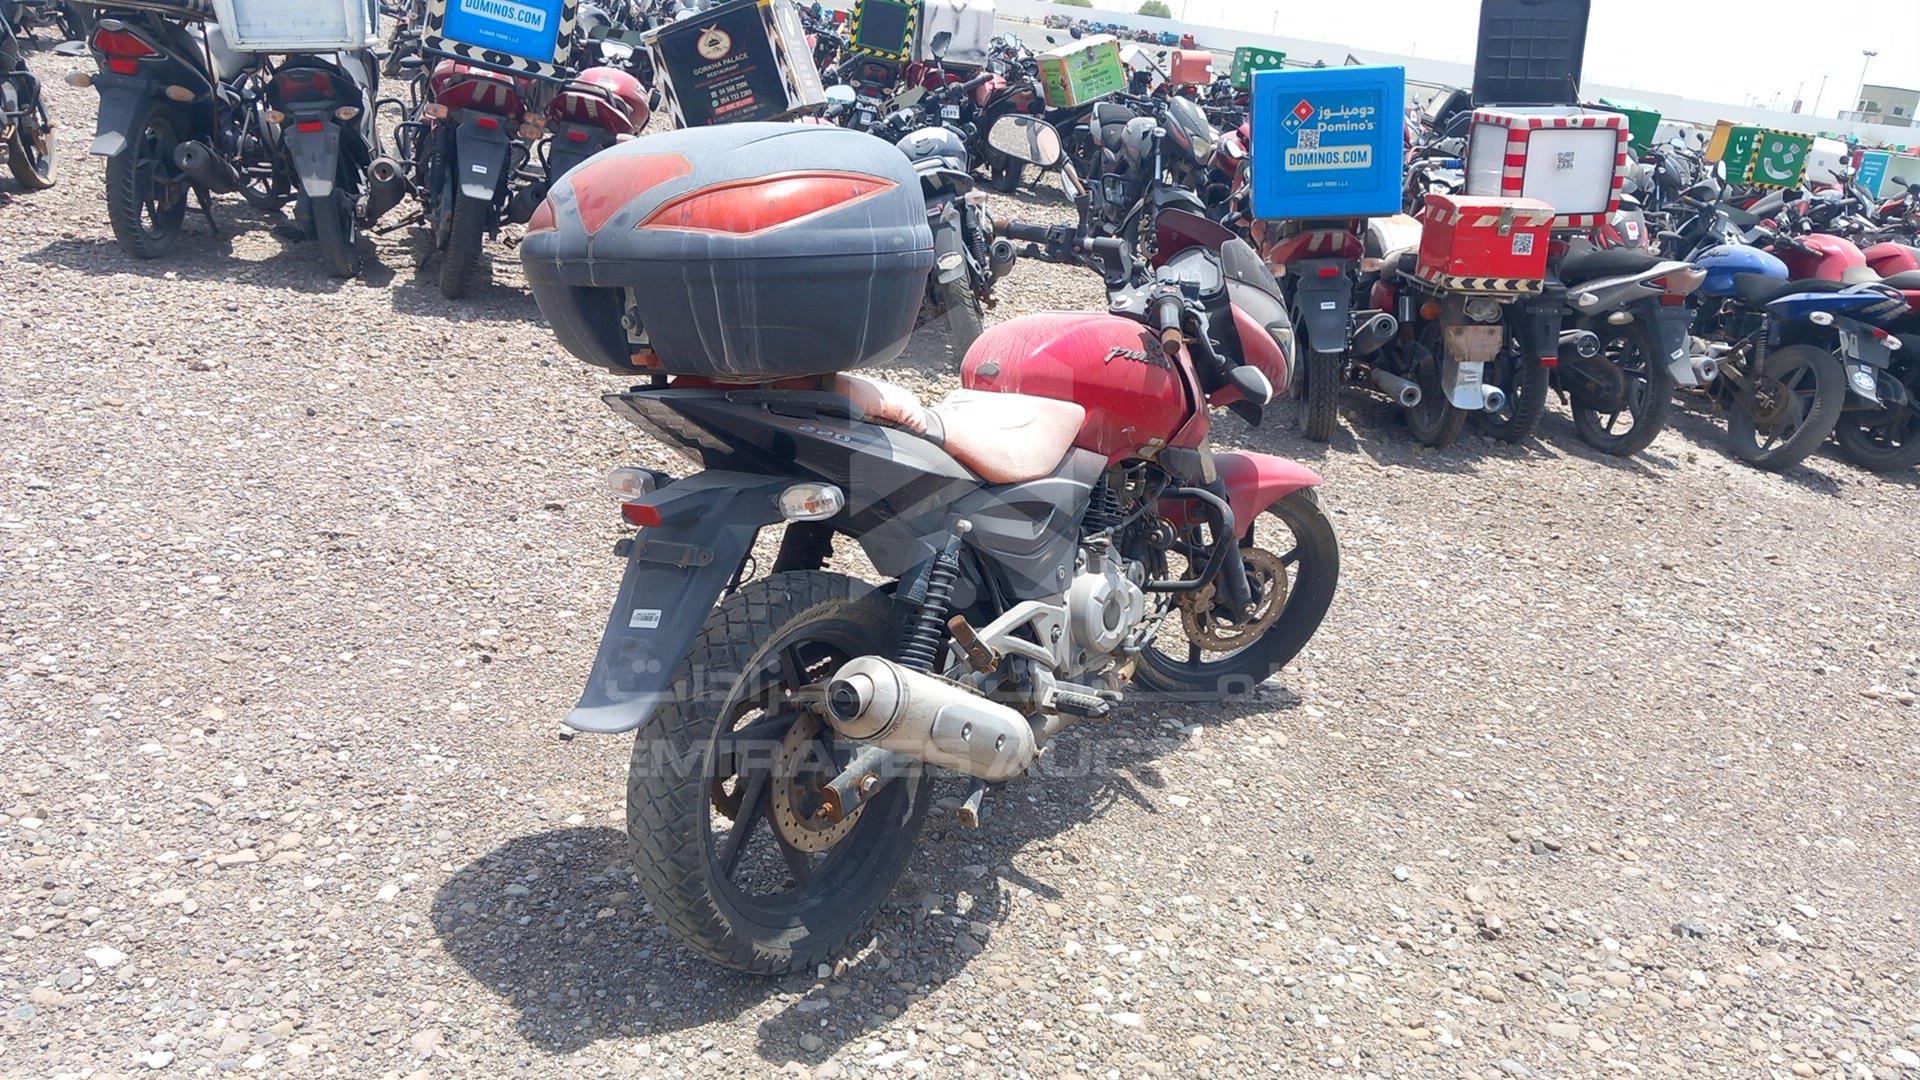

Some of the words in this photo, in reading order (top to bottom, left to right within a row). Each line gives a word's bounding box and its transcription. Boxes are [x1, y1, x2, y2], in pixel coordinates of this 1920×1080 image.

[465, 0, 542, 26] DOMINOS.COM
[693, 62, 722, 75] GORKHA
[723, 53, 748, 65] PALACE
[707, 64, 739, 77] RESTAURANT
[1317, 104, 1375, 120] دومينوز
[1318, 120, 1374, 132] Domino's
[1289, 150, 1368, 166] DOMINOS.COM
